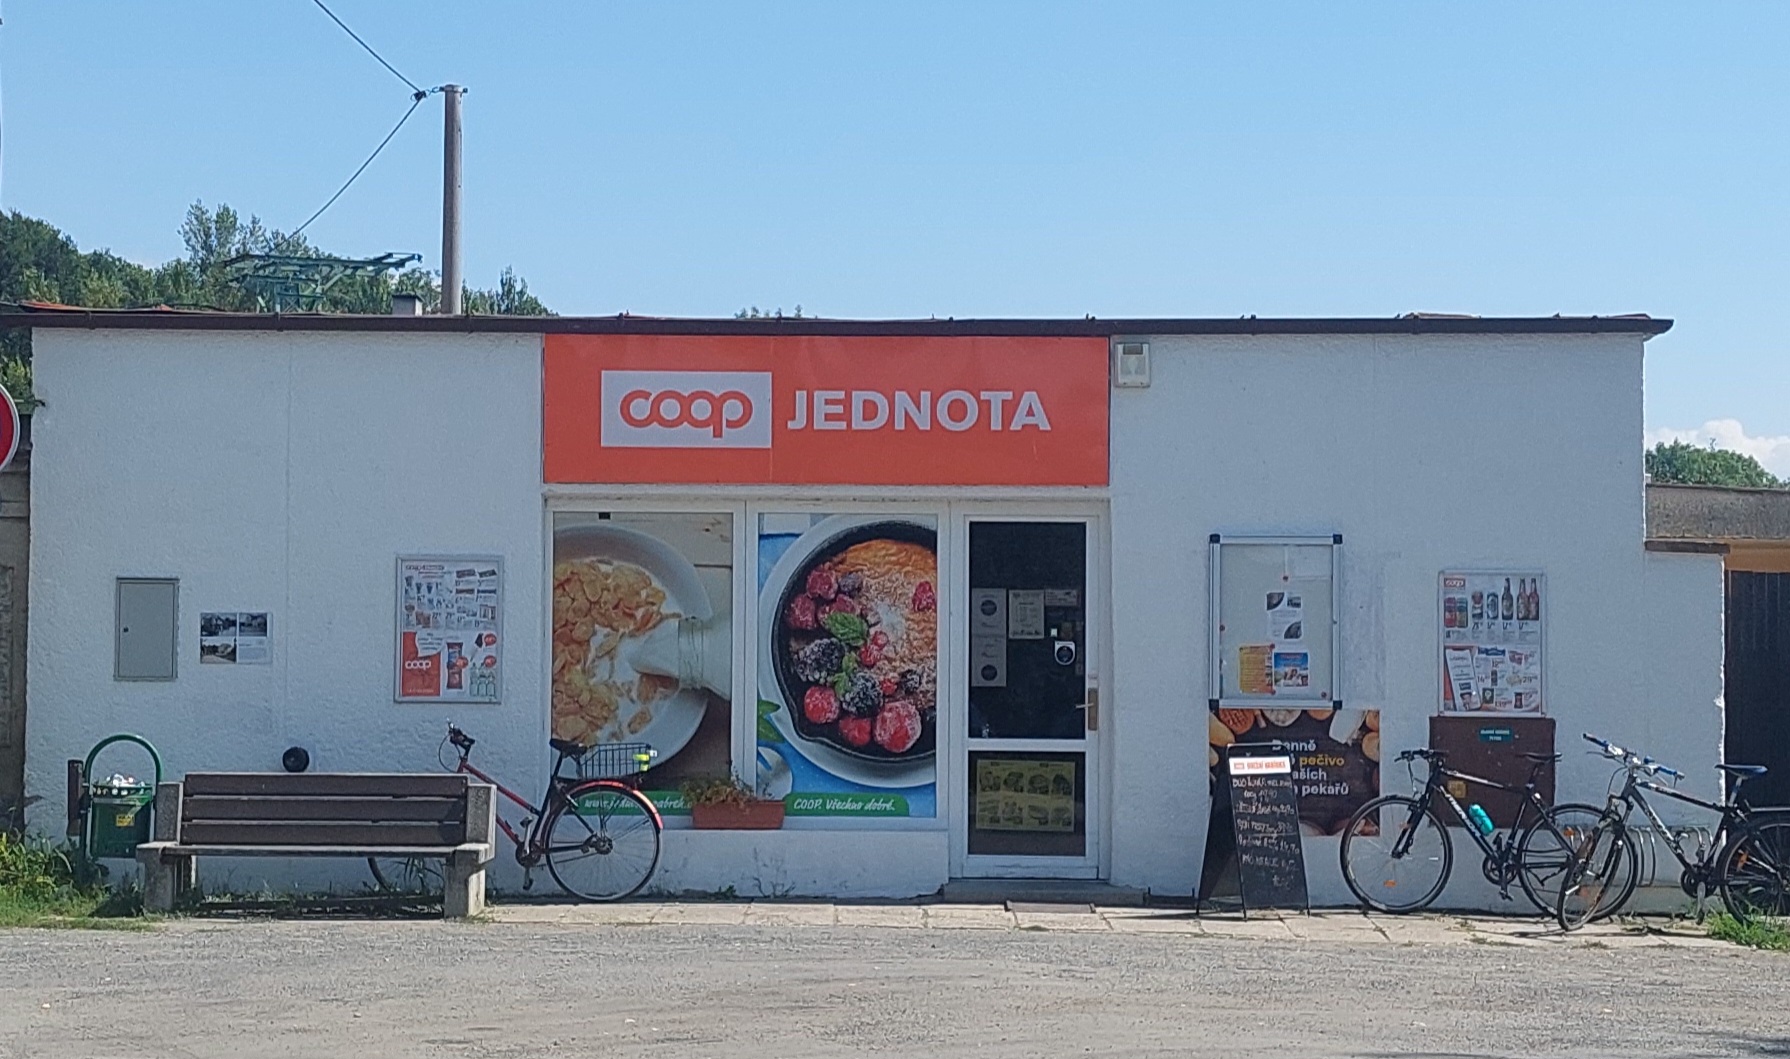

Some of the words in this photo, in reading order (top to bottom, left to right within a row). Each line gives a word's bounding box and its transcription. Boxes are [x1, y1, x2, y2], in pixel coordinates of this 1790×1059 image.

[619, 390, 754, 438] coop
[787, 391, 1052, 431] JEDNOTA
[405, 660, 431, 671] coop
[1299, 754, 1345, 768] pečivo
[1302, 783, 1349, 797] pekařů
[825, 798, 863, 811] Všechno
